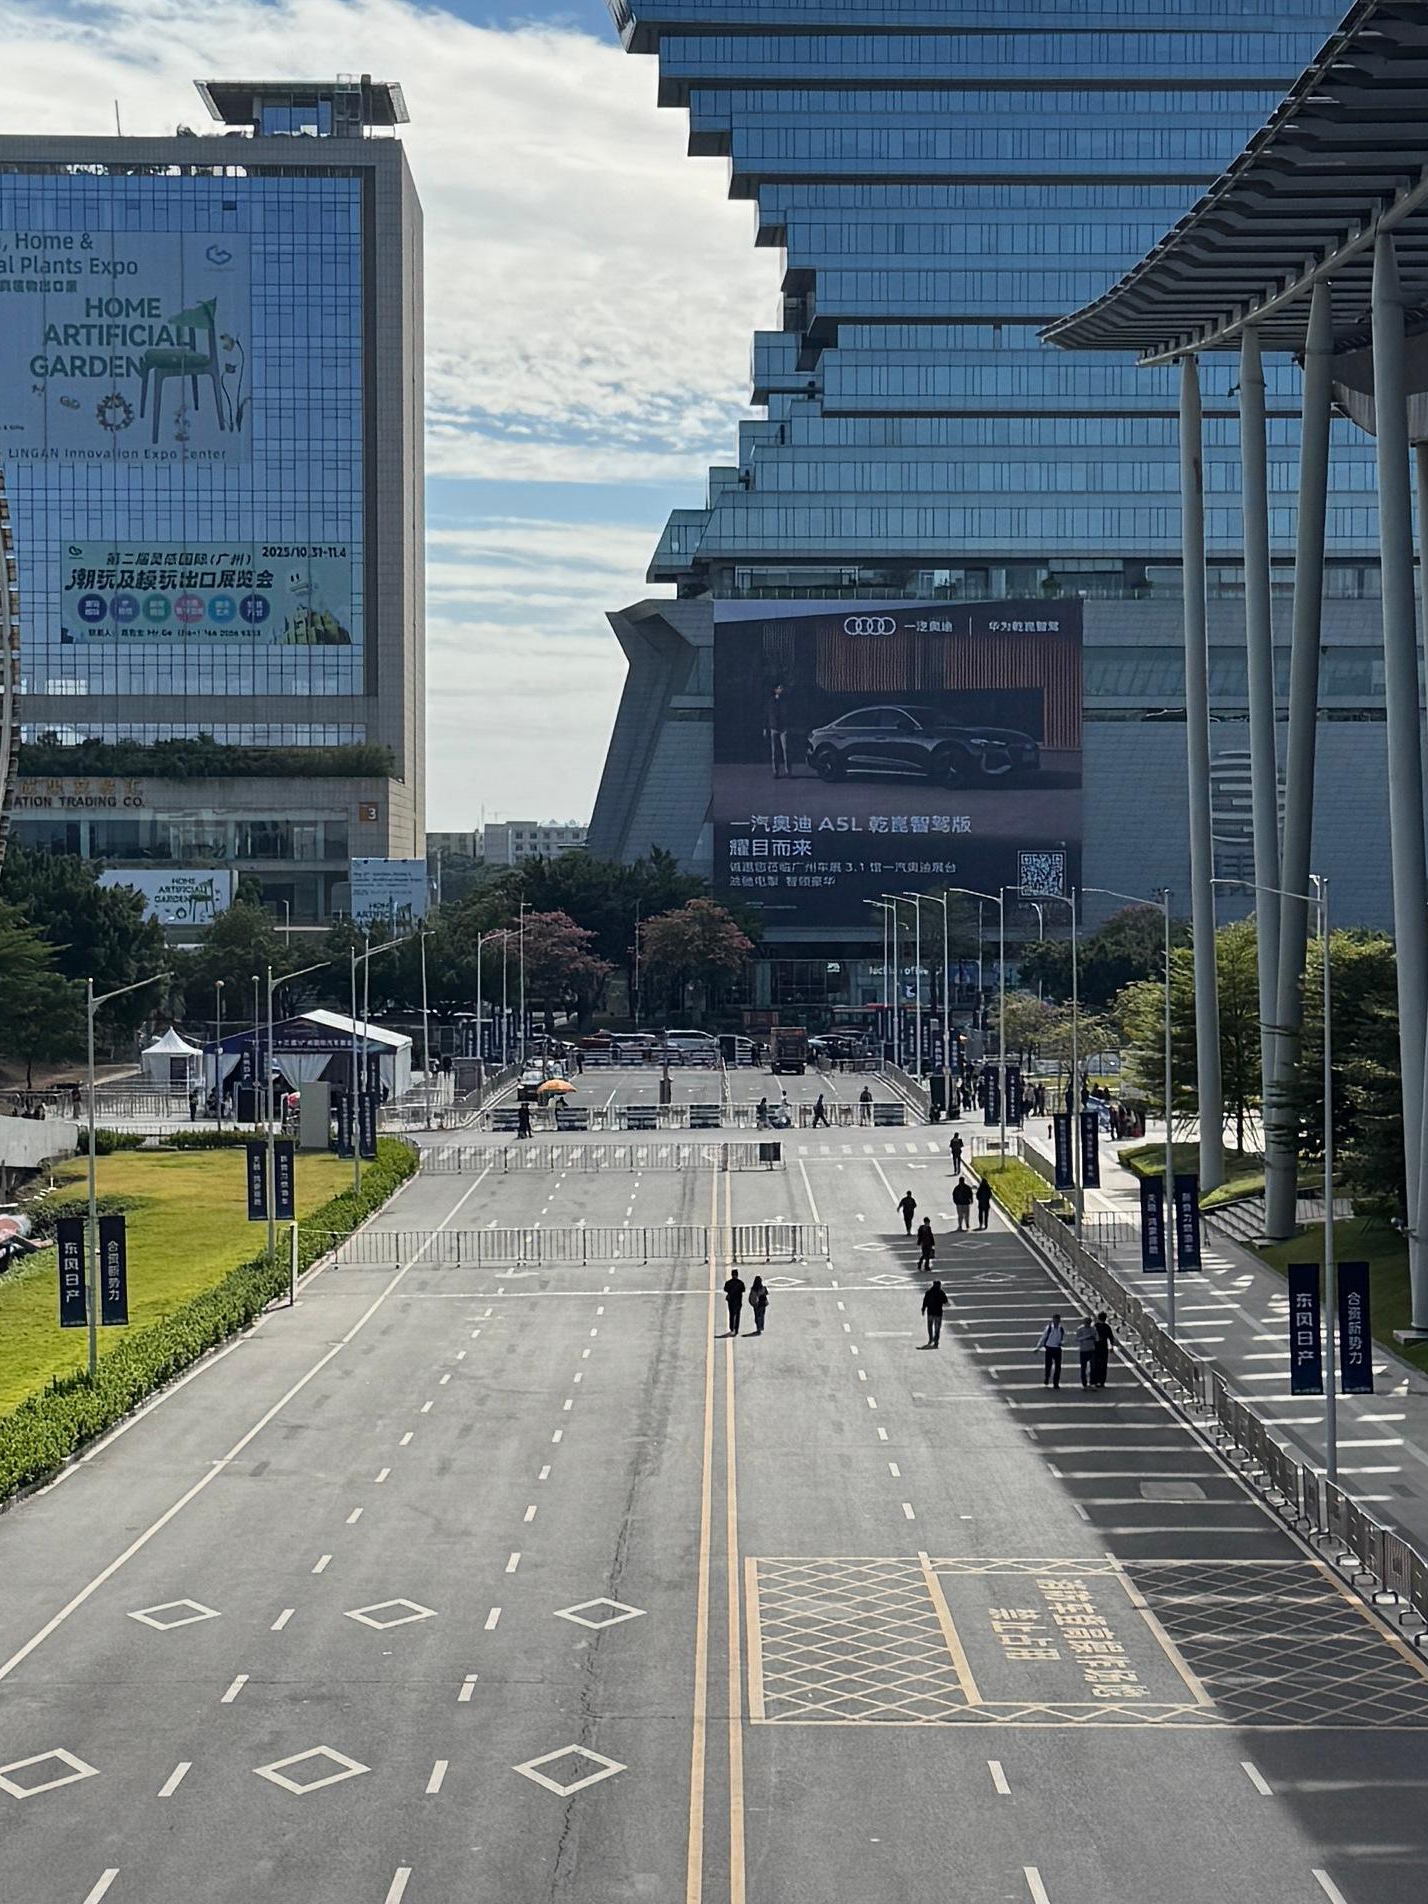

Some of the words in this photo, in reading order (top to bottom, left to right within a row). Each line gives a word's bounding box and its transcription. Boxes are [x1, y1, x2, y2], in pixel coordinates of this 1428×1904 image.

[15, 232, 74, 250] Home
[80, 232, 93, 250] &
[21, 256, 82, 275] Plants
[89, 257, 138, 279] Expo
[84, 297, 162, 319] HOME
[43, 324, 191, 346] ARTIFICIAL
[29, 355, 145, 378] GARDEN
[65, 447, 138, 459] Innovation
[144, 447, 177, 462] Expo
[182, 448, 226, 459] Center
[60, 796, 117, 808] TRADING
[123, 796, 145, 808] CO.
[367, 807, 377, 820] 3
[730, 814, 813, 833] 一汽奥迪
[818, 816, 863, 832] A5L
[845, 862, 864, 873] 3.1
[64, 1242, 80, 1304] 东风日产
[1296, 1292, 1314, 1367] 东风日产
[988, 1606, 1063, 1662] 禁止占用
